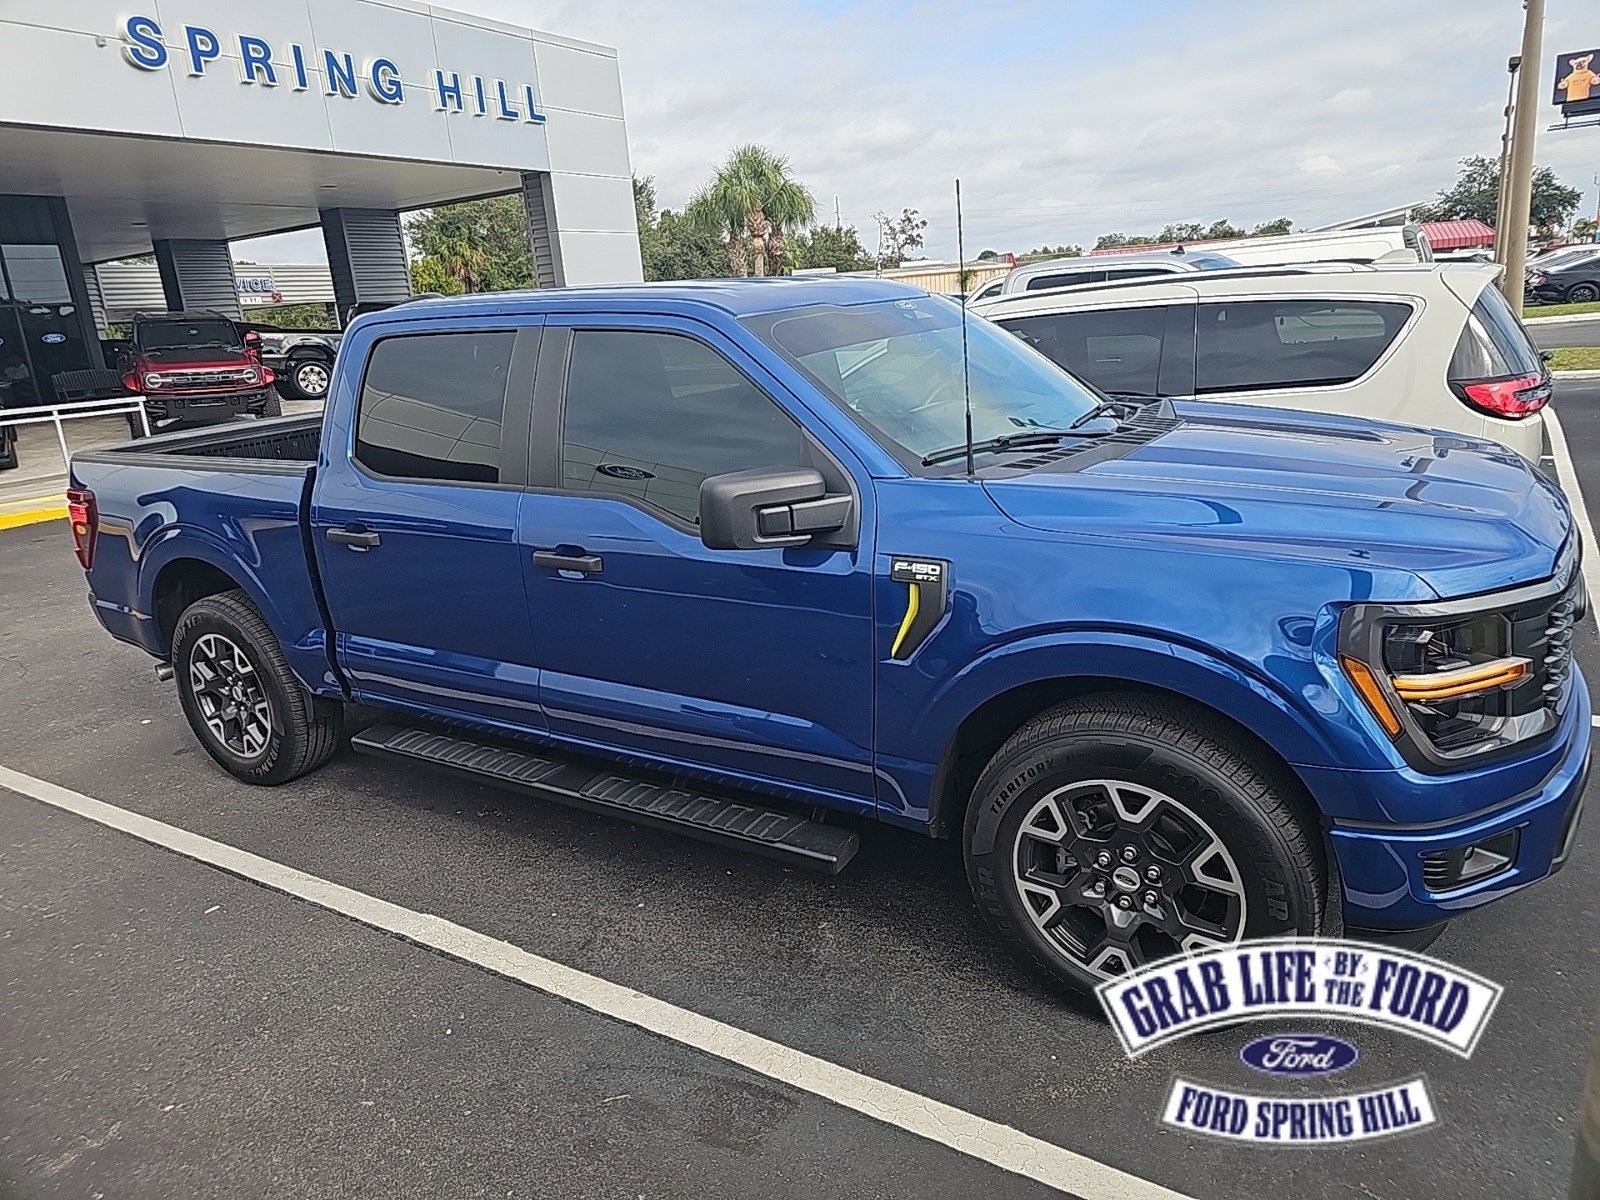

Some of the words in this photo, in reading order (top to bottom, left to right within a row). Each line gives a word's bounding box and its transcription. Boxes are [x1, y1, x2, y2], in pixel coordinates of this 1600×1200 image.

[125, 14, 404, 103] SPRING
[433, 69, 547, 123] HILL
[894, 561, 940, 575] F-150
[989, 758, 1054, 815] TERRITORY
